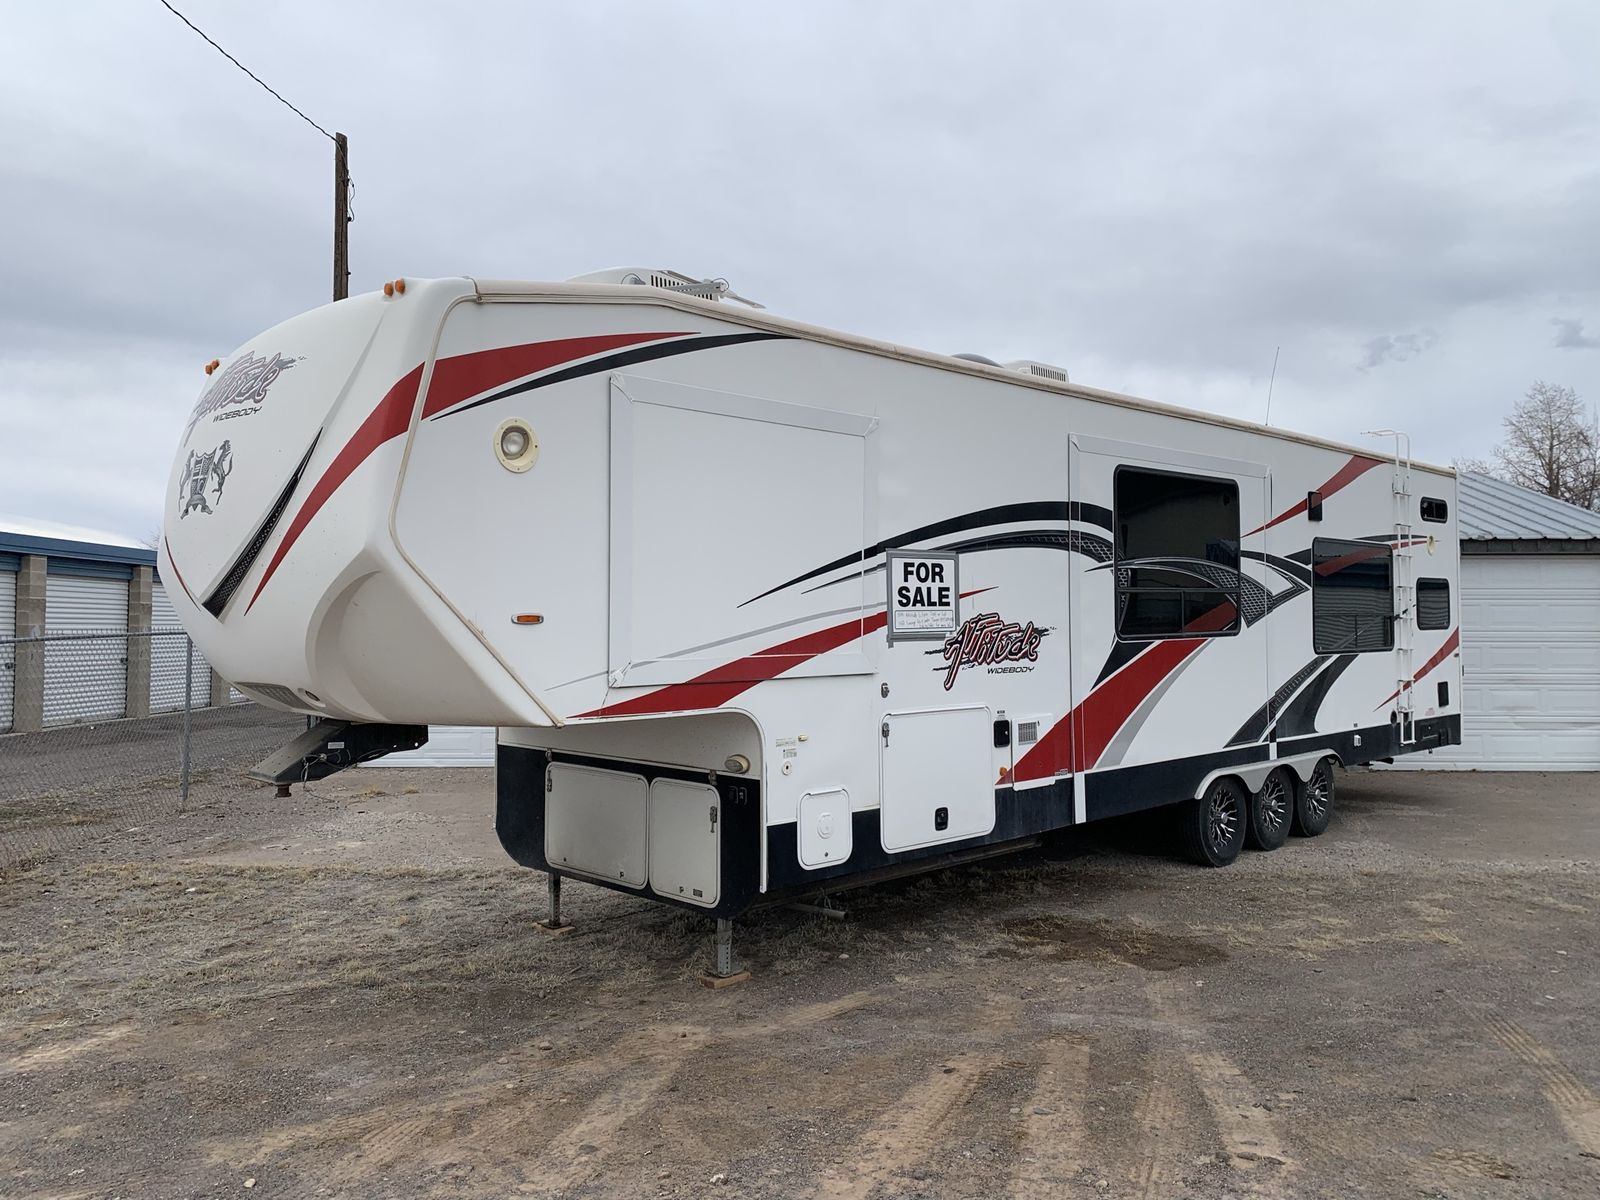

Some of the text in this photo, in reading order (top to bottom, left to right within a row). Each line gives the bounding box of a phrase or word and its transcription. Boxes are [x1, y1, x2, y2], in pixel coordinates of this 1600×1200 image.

[213, 406, 262, 422] WIDEBODY
[903, 562, 944, 583] FOR
[897, 586, 951, 608] SALE
[987, 666, 1035, 675] WIDEBODY
